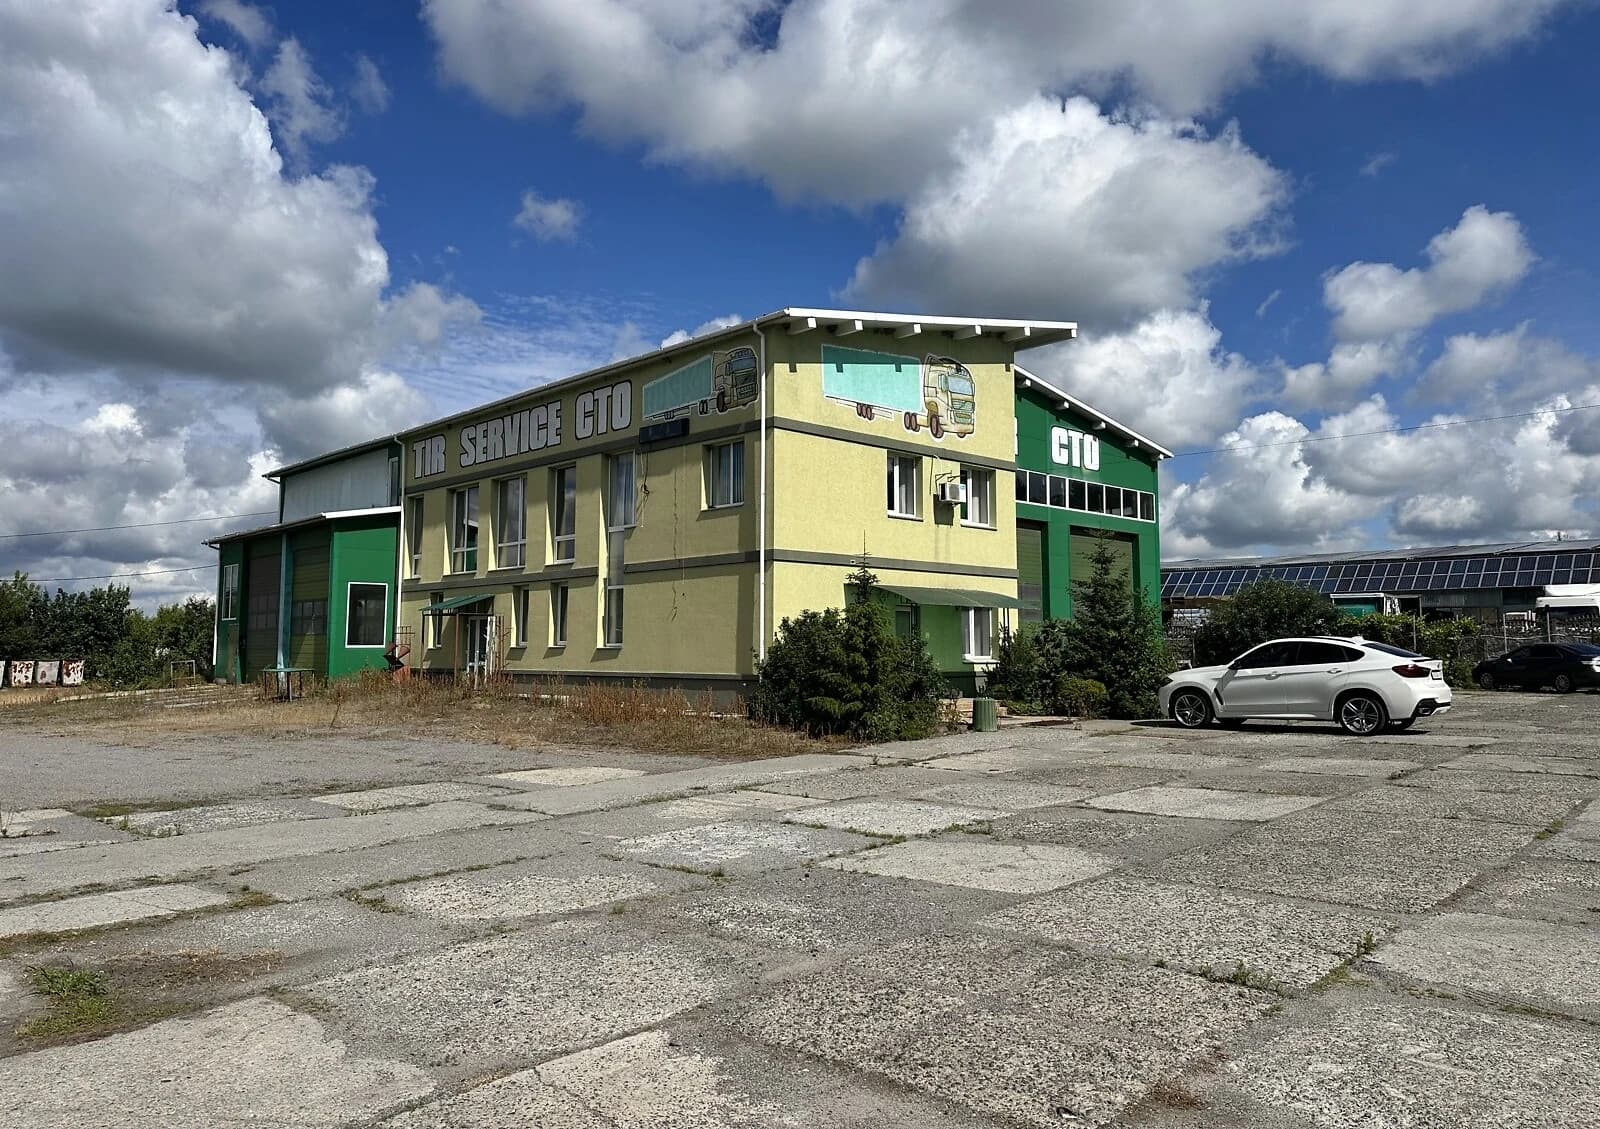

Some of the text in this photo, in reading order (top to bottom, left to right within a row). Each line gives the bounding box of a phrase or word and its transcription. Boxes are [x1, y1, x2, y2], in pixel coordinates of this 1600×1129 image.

[413, 379, 632, 479] TIR SERVICE СТО
[1051, 426, 1100, 471] СТО
